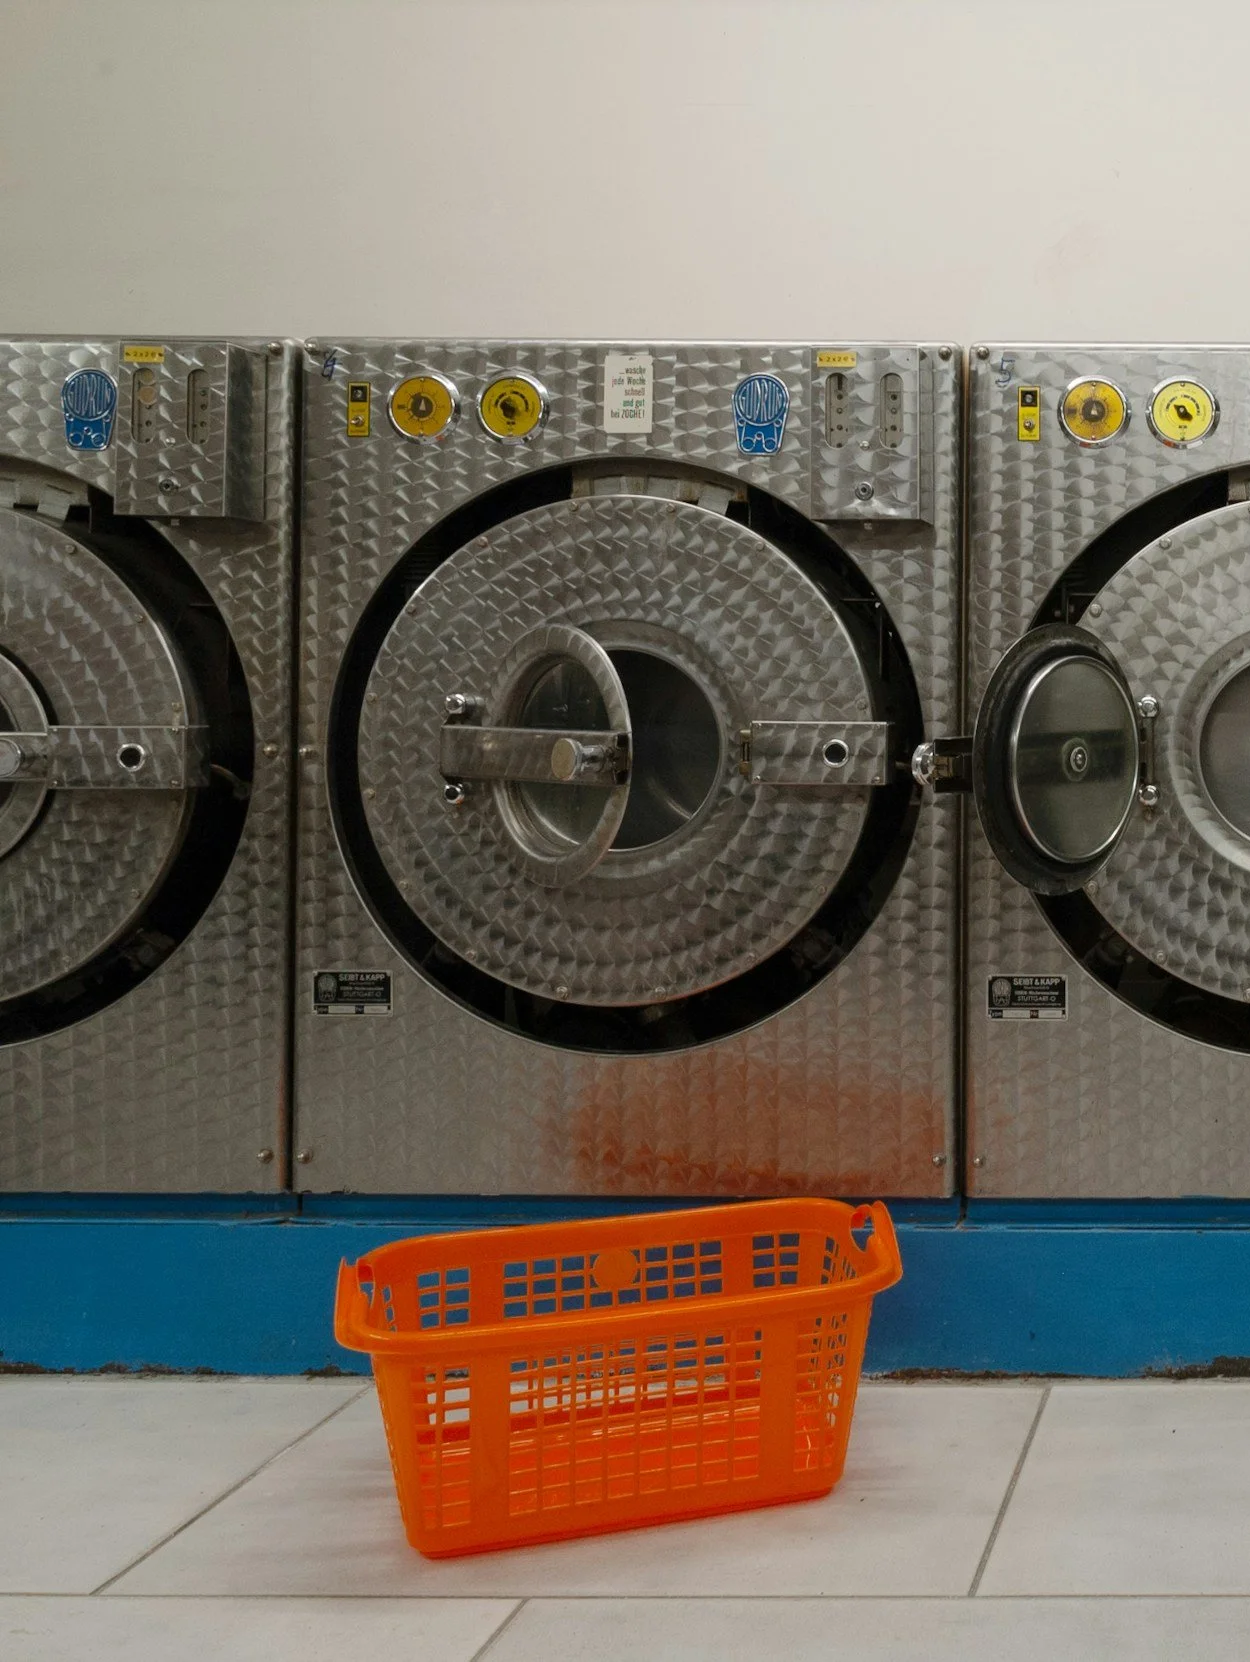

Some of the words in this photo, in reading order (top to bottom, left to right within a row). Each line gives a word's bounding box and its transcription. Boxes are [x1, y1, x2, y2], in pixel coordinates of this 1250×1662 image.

[995, 357, 1016, 388] 5
[611, 377, 624, 387] jede
[627, 377, 646, 385] Woche
[66, 373, 112, 418] GUDRUN
[624, 388, 645, 396] schnell
[623, 399, 633, 407] und
[738, 379, 783, 422] GUDRUN
[611, 410, 620, 418] bei
[1040, 978, 1061, 986] KAPP
